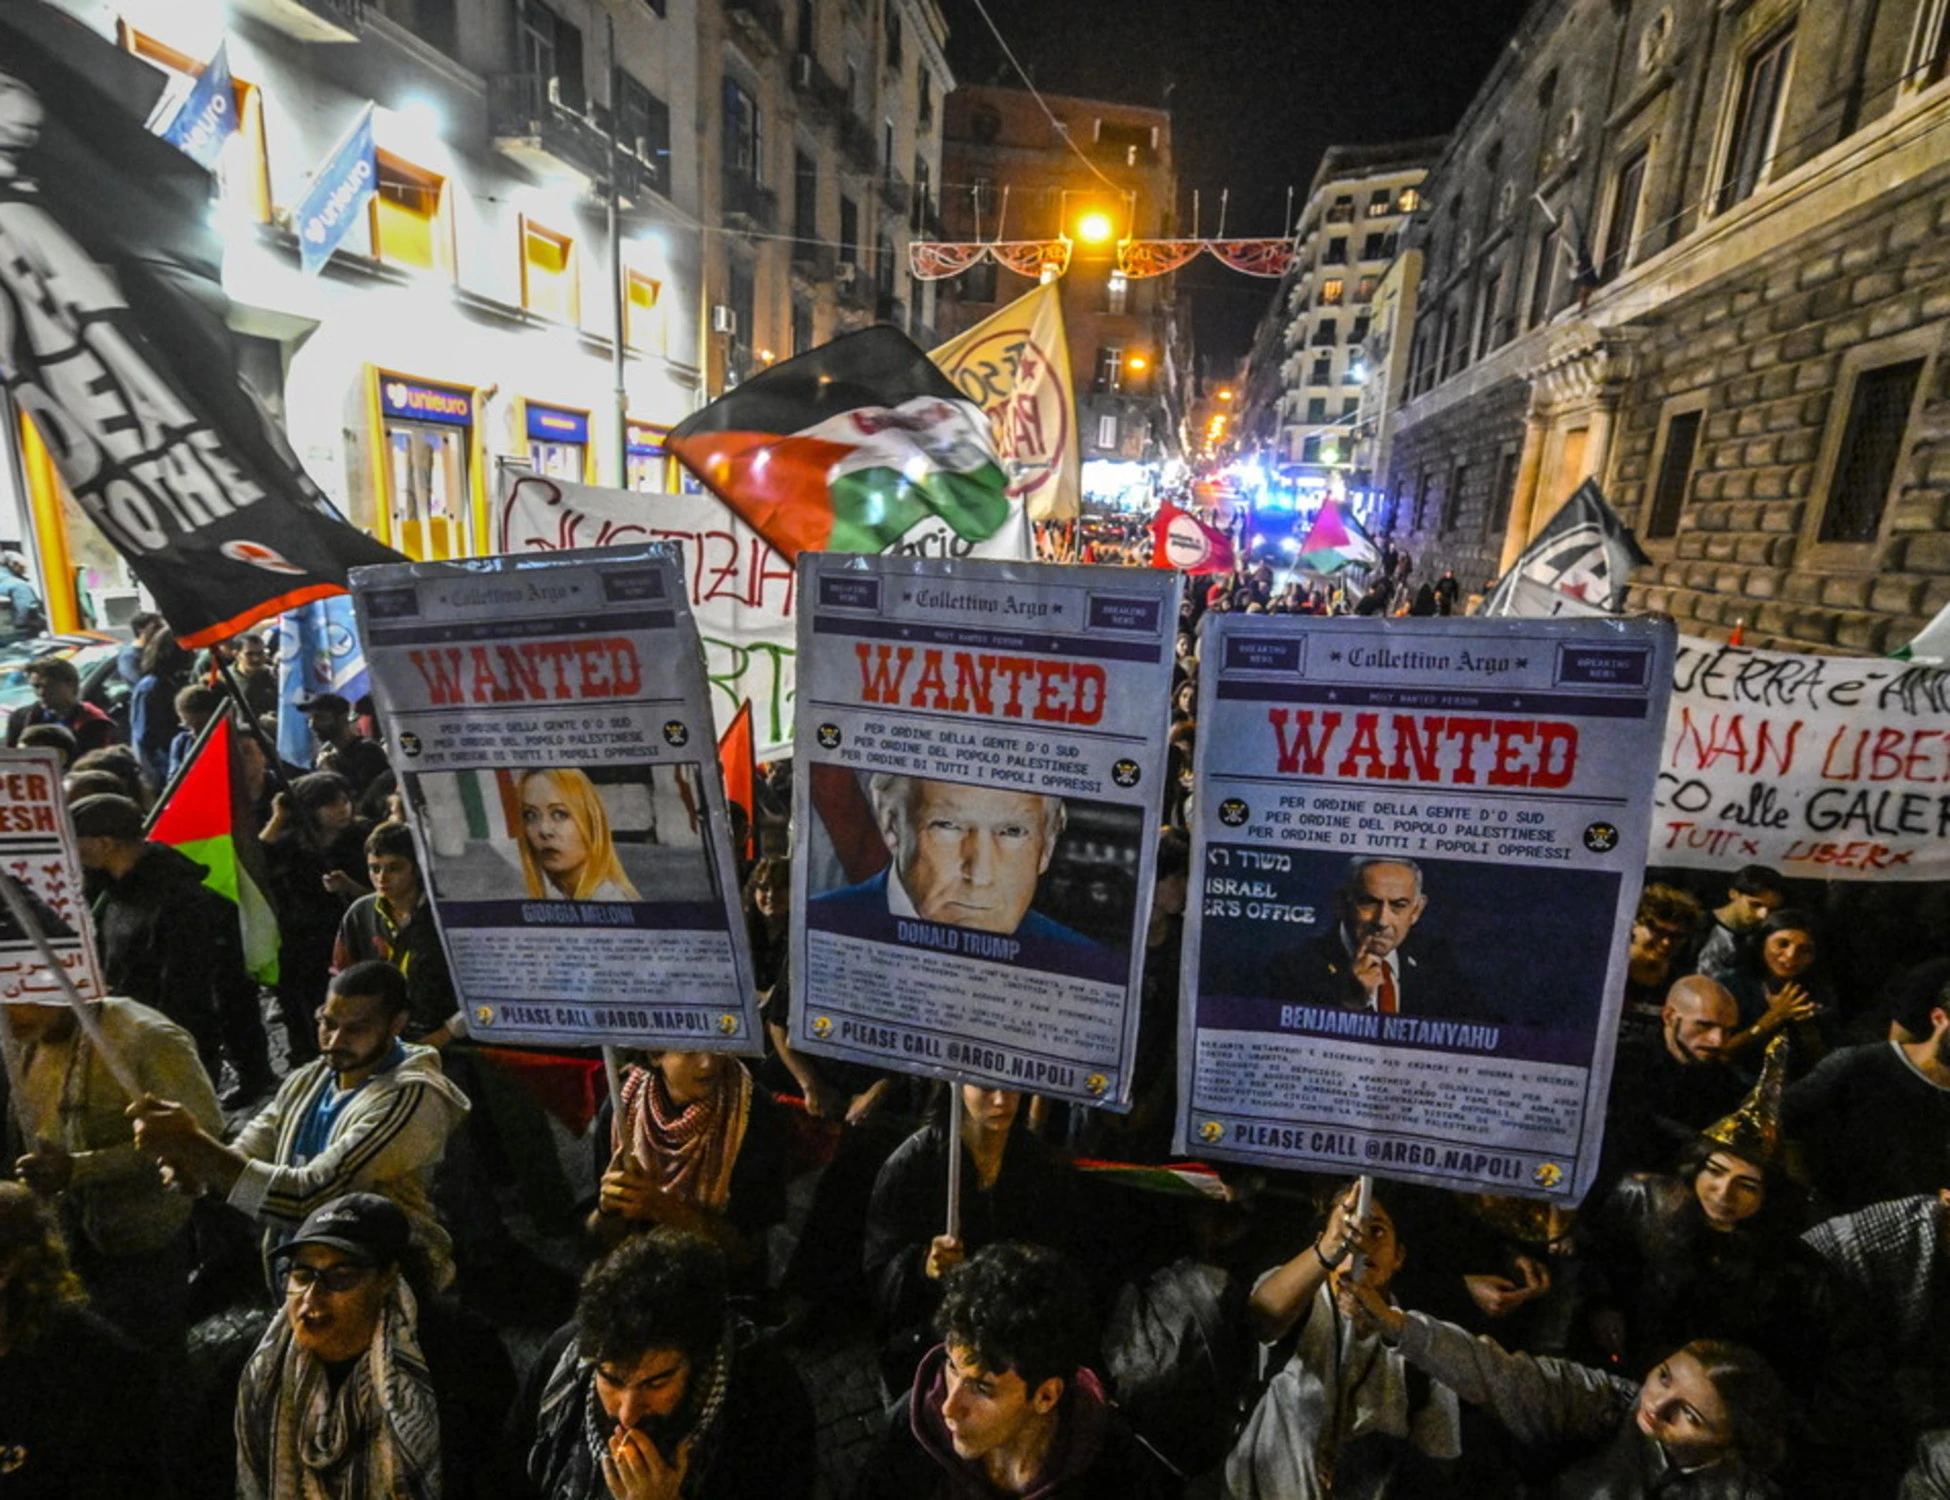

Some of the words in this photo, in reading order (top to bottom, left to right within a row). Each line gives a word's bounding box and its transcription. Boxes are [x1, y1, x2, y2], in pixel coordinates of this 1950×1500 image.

[320, 160, 371, 227] unieuro
[407, 391, 468, 416] unieuro
[1003, 594, 1048, 619] Argo
[410, 636, 643, 705] WANTED
[1455, 650, 1510, 676] Argo
[855, 642, 1107, 727] WANTED
[854, 736, 875, 747] PER
[880, 739, 922, 754] ORDINE
[928, 745, 948, 758] DEL
[956, 748, 1000, 763] POPOLO
[1007, 755, 1089, 776] PALESTINESE
[864, 722, 885, 735] PER
[891, 726, 933, 740] ORDINE
[940, 731, 976, 745] DELLA
[983, 737, 1018, 751] GENTE
[1026, 741, 1049, 755] D'O
[1056, 745, 1080, 758] SUD
[1268, 708, 1580, 790] WANTED
[1672, 706, 1804, 777] NAN
[841, 748, 861, 760] PER
[867, 752, 907, 767] ORDINE
[913, 760, 927, 770] DI
[935, 761, 969, 775] TUTTI
[977, 766, 983, 778] I
[991, 768, 1035, 784] POPOLI
[1041, 774, 1102, 793] OPPRESSI
[1279, 796, 1305, 809] PER
[1313, 798, 1366, 814] ORDINE
[1373, 802, 1418, 817] DELLA
[1426, 806, 1472, 821] GENTE
[1480, 809, 1508, 823] D'O
[1516, 811, 1545, 825] SUD
[1719, 782, 1790, 830] alle
[1248, 825, 1274, 839] PER
[1281, 828, 1332, 844] ORDINE
[1340, 832, 1357, 845] DI
[1367, 833, 1409, 849] TUTTI
[1418, 838, 1426, 850] I
[1436, 839, 1489, 856] POPOLI
[1498, 843, 1572, 860] OPPRESSI
[1266, 811, 1292, 824] PER
[1299, 813, 1350, 829] ORDINE
[1358, 818, 1384, 831] DEL
[1394, 820, 1448, 836] POPOLO
[1455, 824, 1556, 843] PALESTINESE
[1236, 850, 1292, 872] משרד
[1206, 878, 1278, 898] ISRAEL
[1246, 902, 1316, 924] OFFICE
[898, 920, 959, 951] DONALD
[962, 931, 1021, 961] TRUMP
[501, 1006, 552, 1024] PLEASE
[556, 1008, 590, 1027] CALL
[1280, 1004, 1379, 1041] BENJAMIN
[1383, 1016, 1500, 1052] NETANYAHU
[842, 1020, 898, 1050] PLEASE
[903, 1032, 942, 1059] CALL
[947, 1042, 1075, 1089] @ARGO.NAPOLI
[1233, 1124, 1305, 1151] PLEASE
[1310, 1133, 1357, 1158] CALL
[1364, 1138, 1523, 1180] @ARGO.NAPOLI
